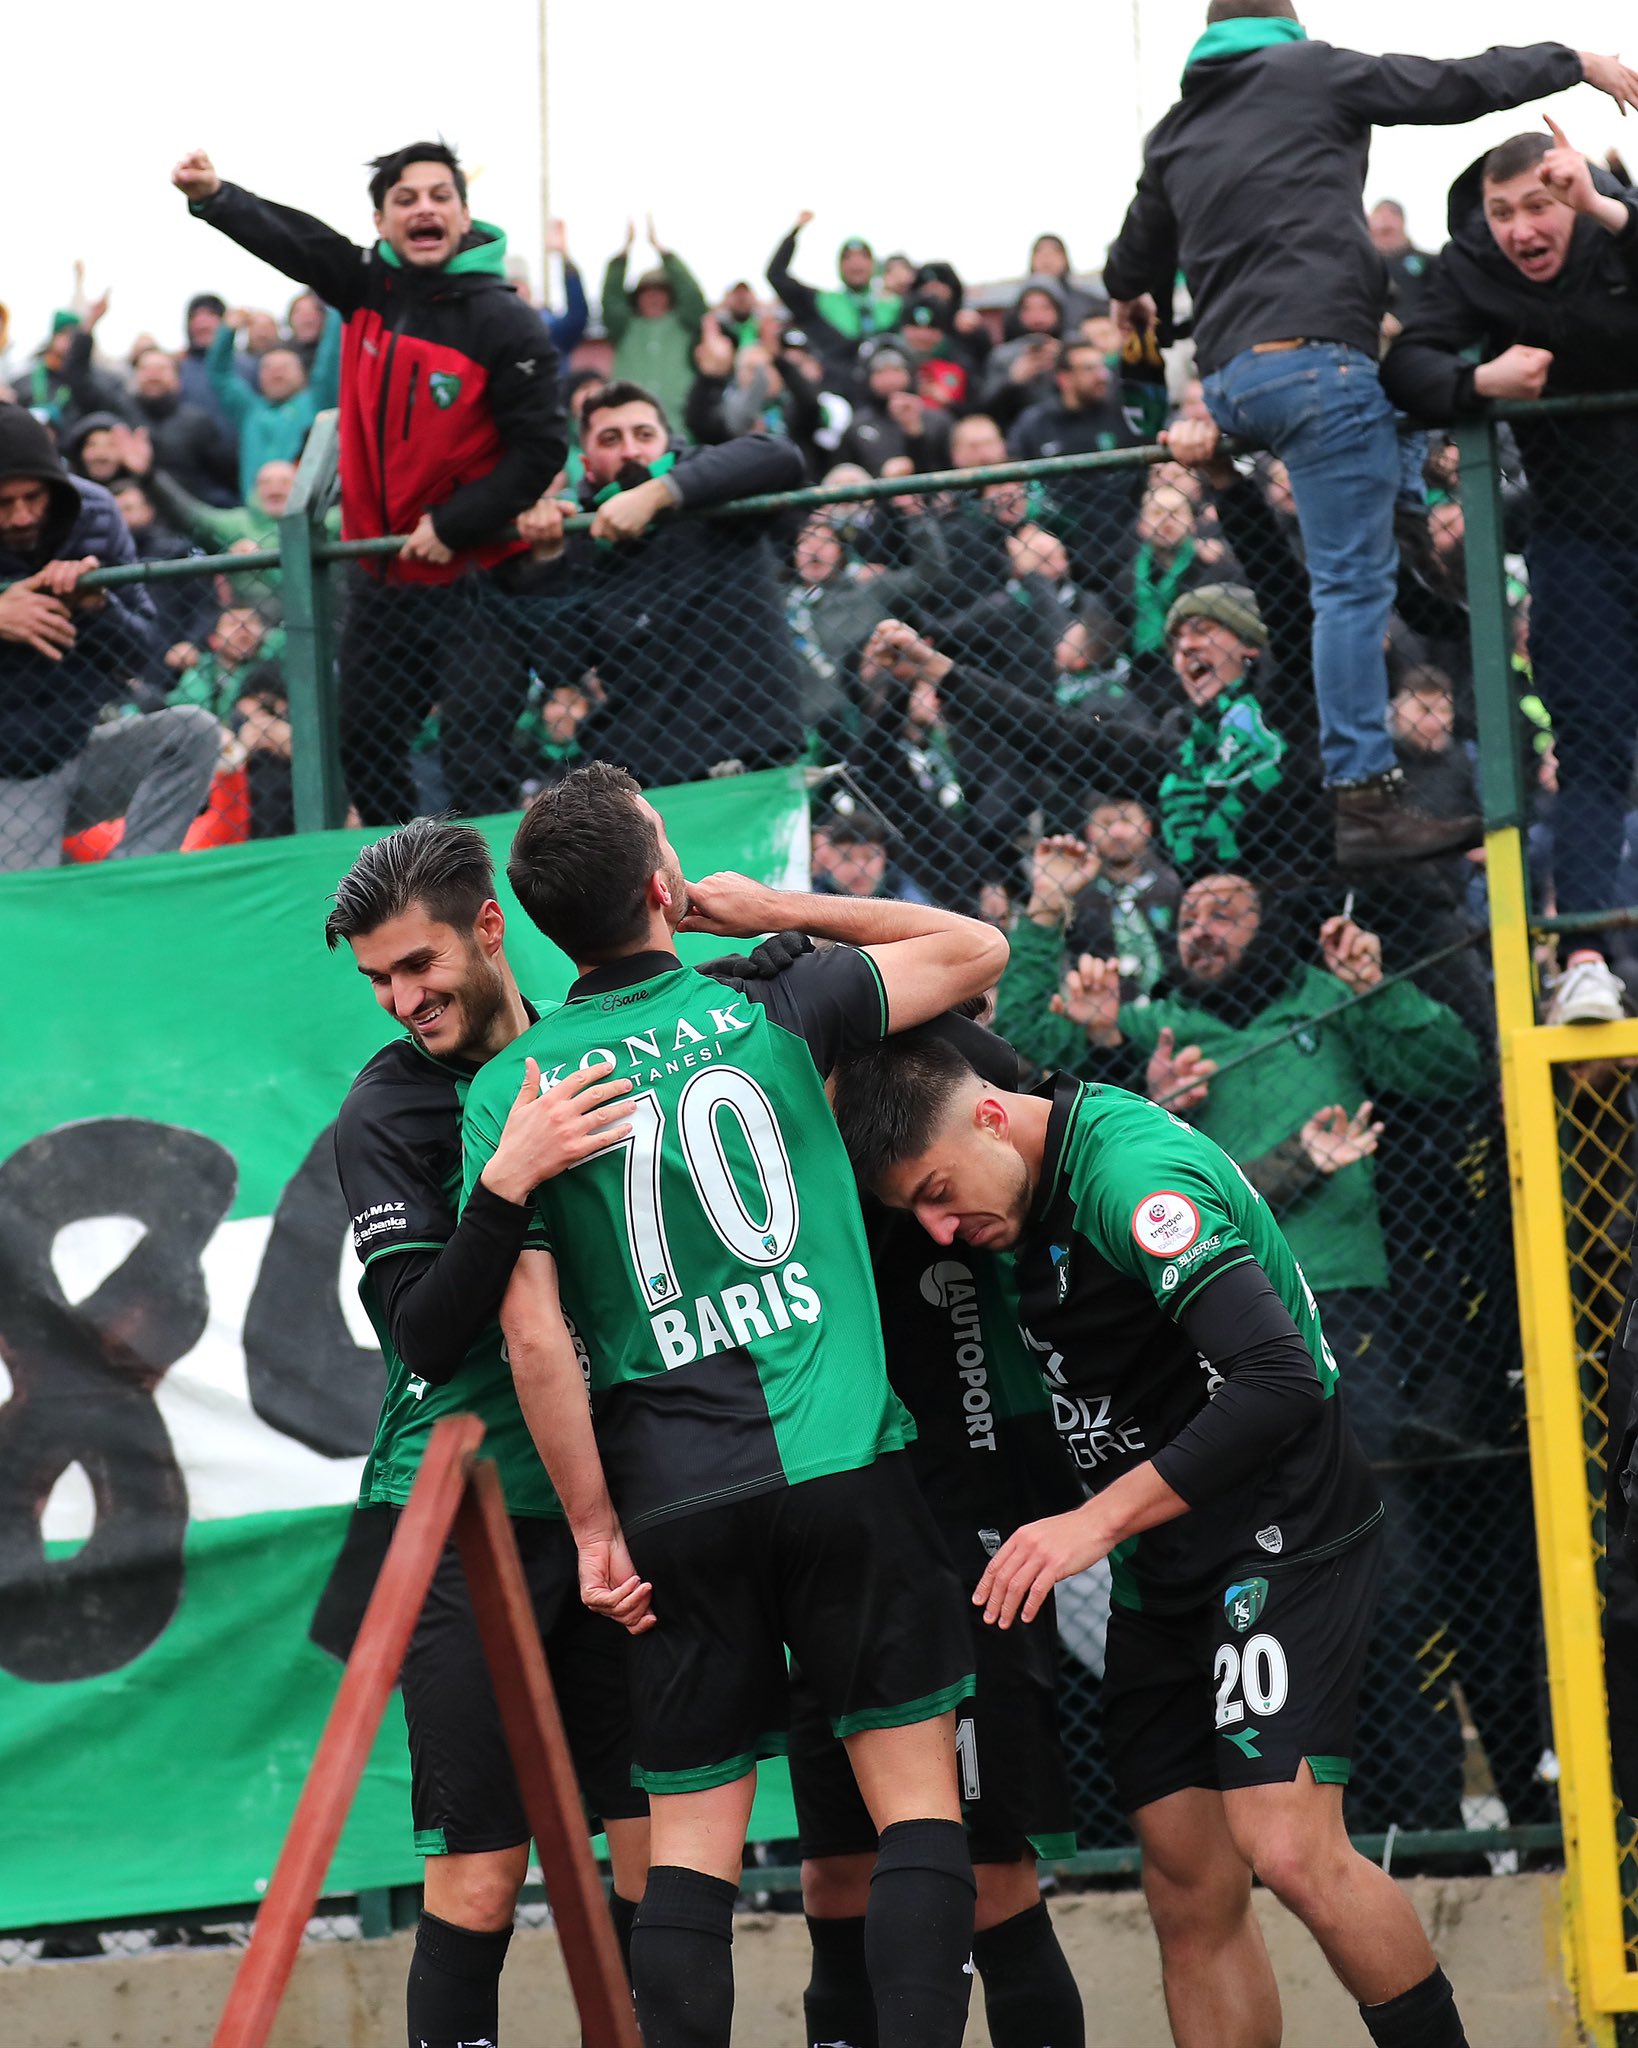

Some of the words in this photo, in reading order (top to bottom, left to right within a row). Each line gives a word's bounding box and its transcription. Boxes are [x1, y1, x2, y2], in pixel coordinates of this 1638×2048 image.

[539, 1002, 752, 1096] KONAK
[630, 1040, 723, 1087] TANESİ
[566, 1064, 800, 1312] 70
[1177, 1234, 1221, 1268] BLUEFOCE
[650, 1261, 822, 1371] BARIŞ
[946, 1282, 997, 1451] AUTOPORT
[1051, 1394, 1112, 1431] DIZ
[1213, 1633, 1289, 1730] 20
